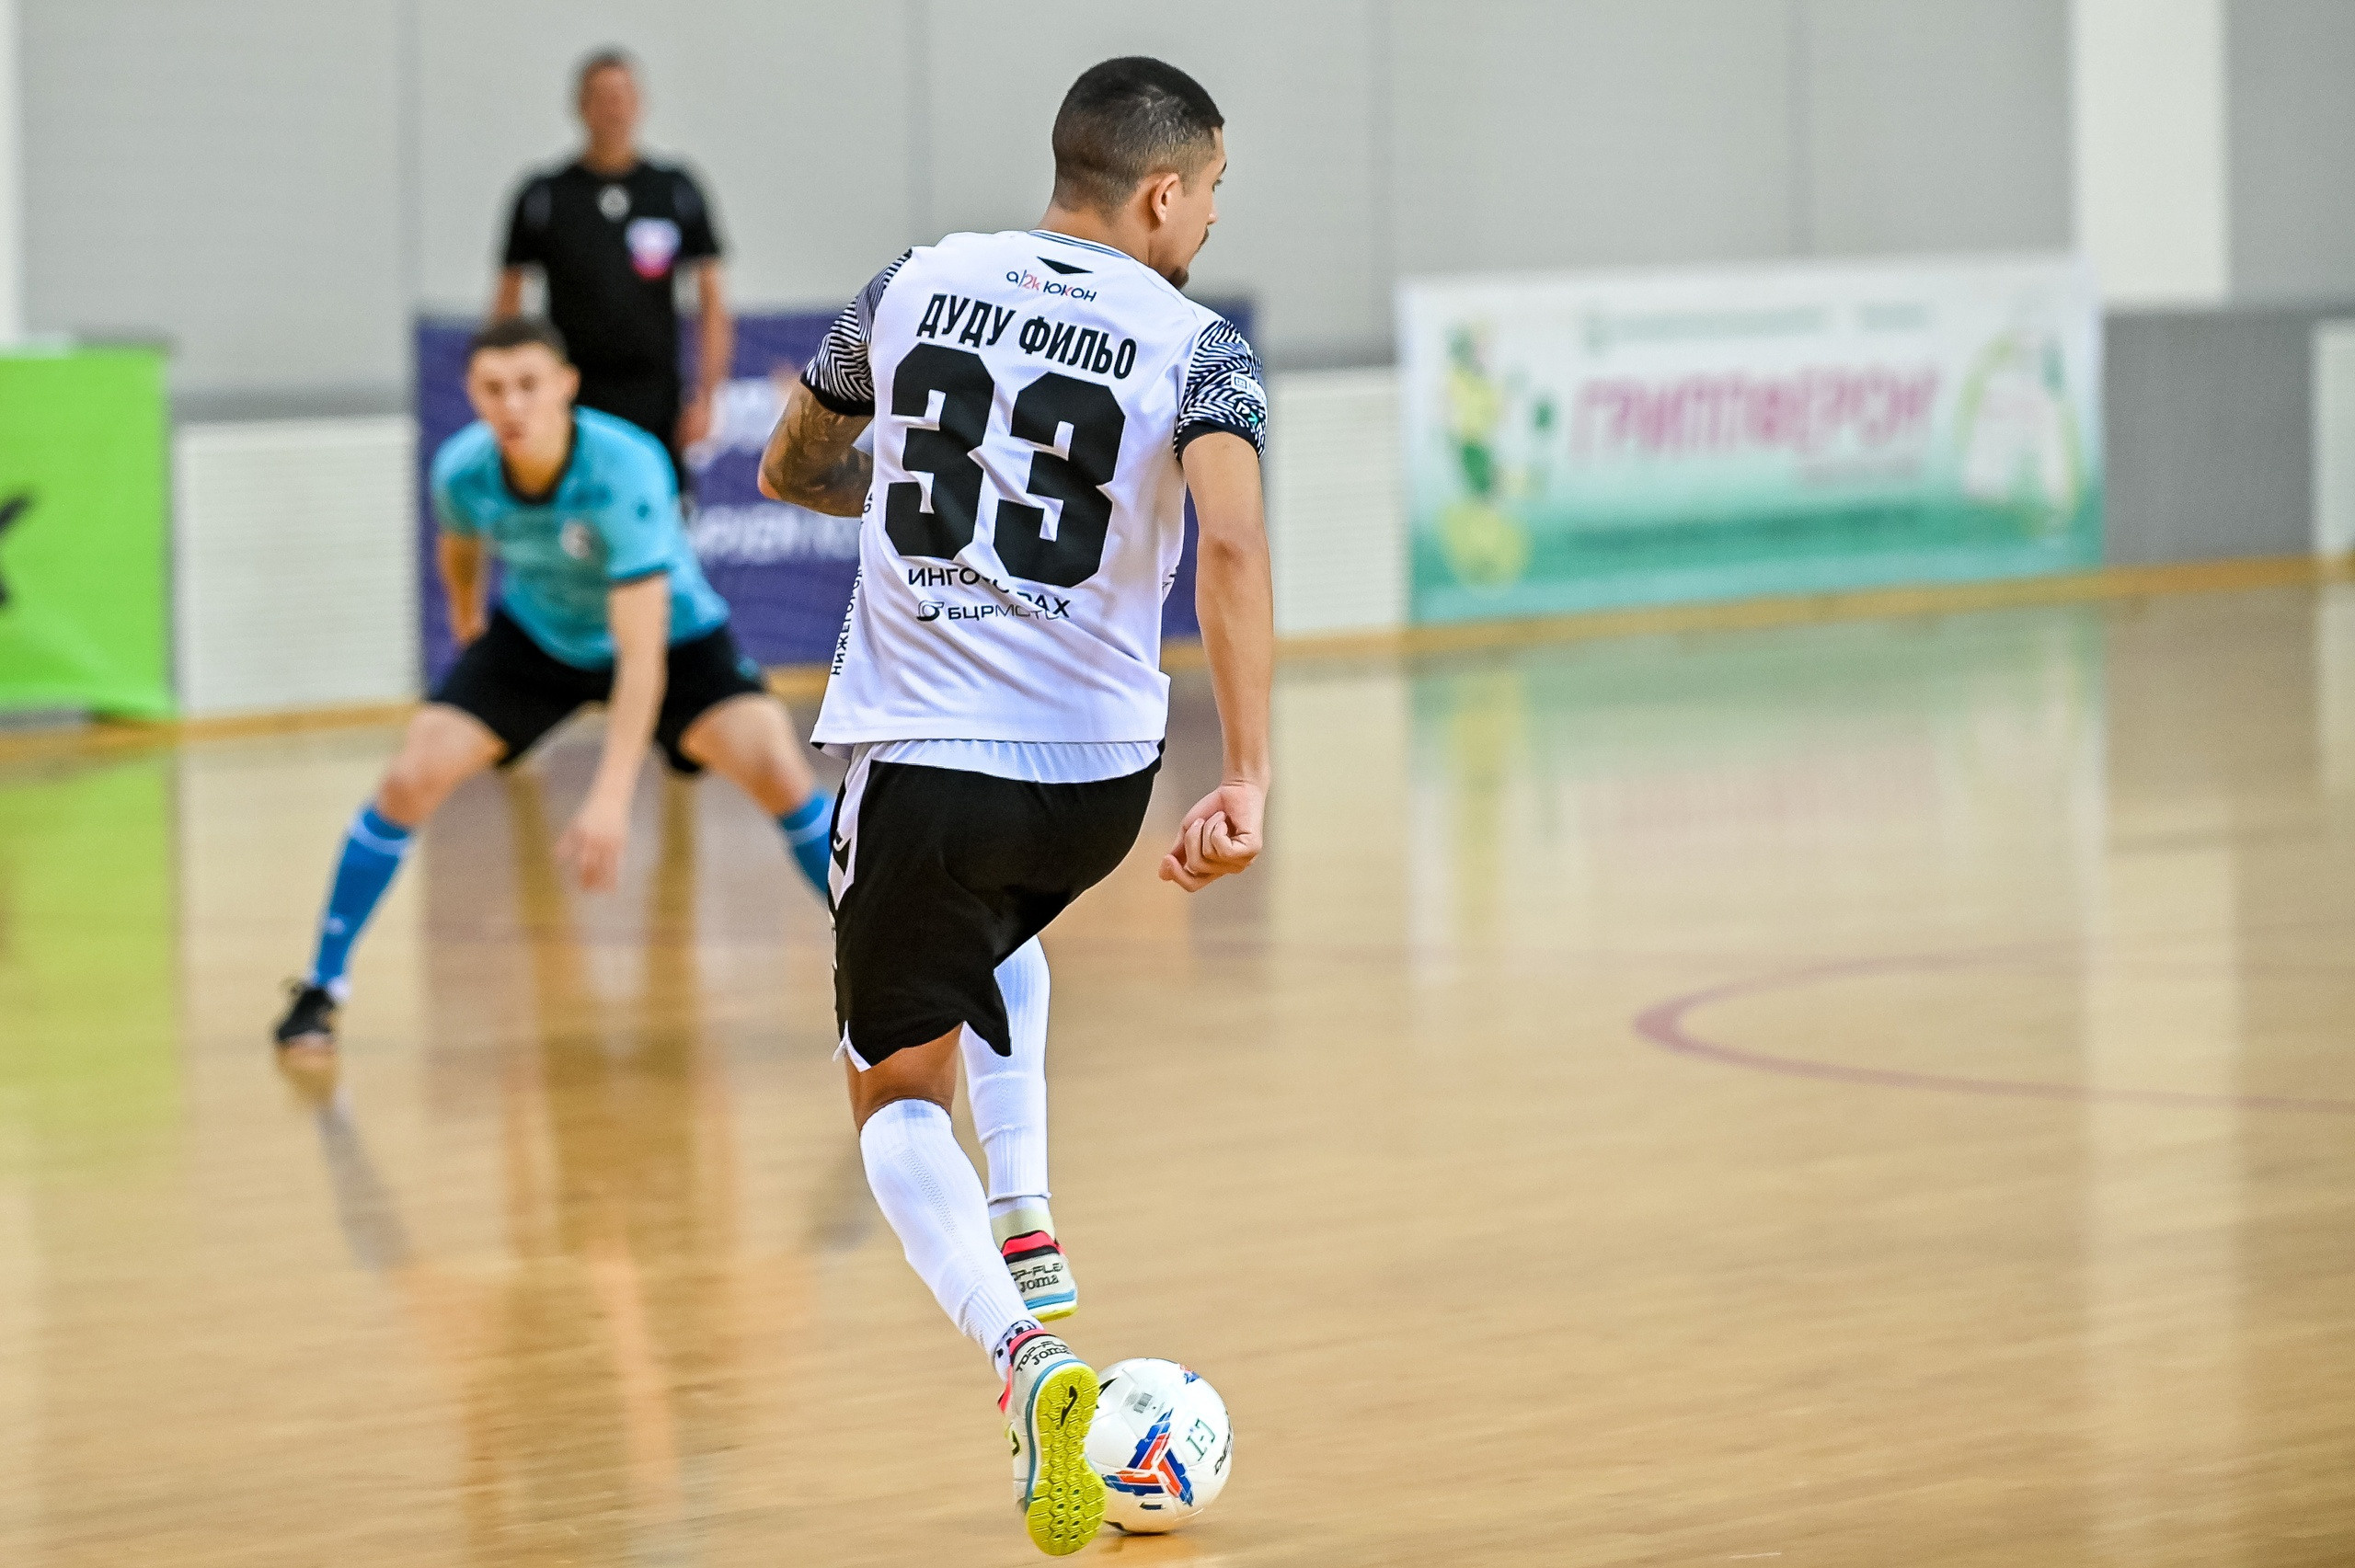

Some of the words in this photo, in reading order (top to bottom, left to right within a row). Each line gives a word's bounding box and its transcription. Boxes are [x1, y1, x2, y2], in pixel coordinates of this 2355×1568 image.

[916, 292, 1017, 349] ДУДУ
[1018, 315, 1137, 380] ФИЛЬО
[885, 342, 1126, 589] 33
